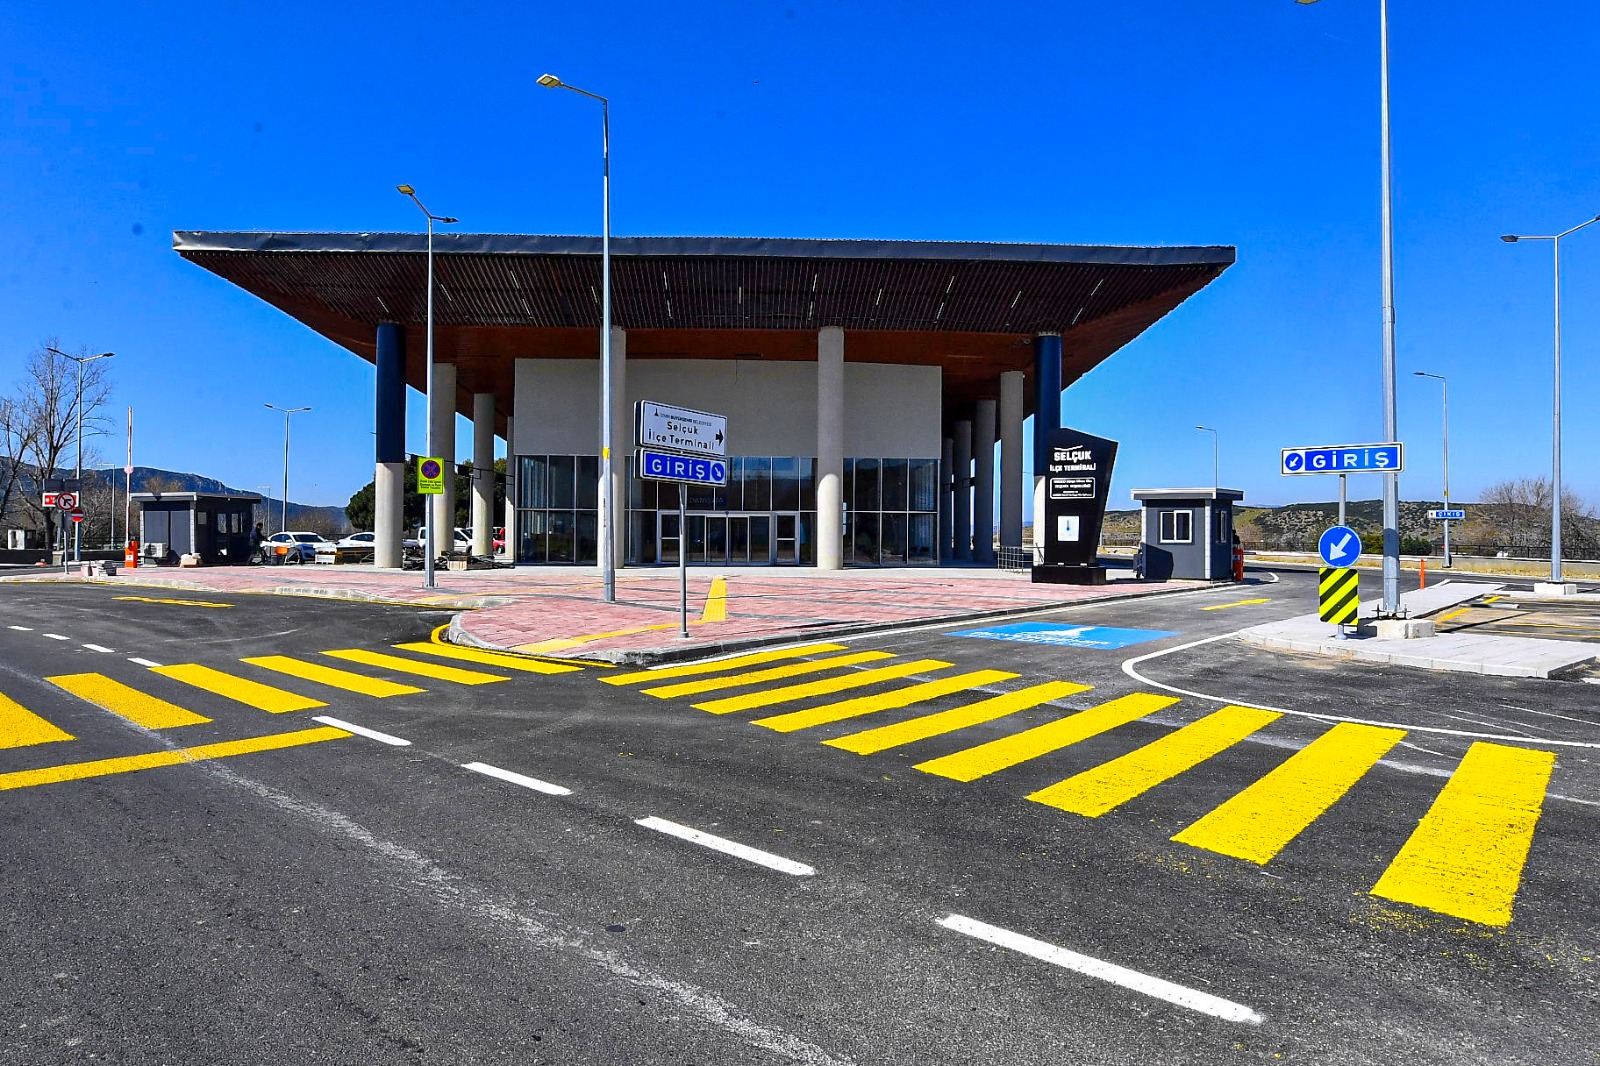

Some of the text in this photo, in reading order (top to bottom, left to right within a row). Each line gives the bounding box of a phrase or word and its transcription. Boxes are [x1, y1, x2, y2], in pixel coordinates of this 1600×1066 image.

[667, 421, 698, 435] Selçuk
[648, 428, 714, 451] İlçe Terminali
[1053, 450, 1092, 463] SELÇUK
[1312, 449, 1390, 468] GİRİŞ
[652, 457, 705, 480] GİRİŞ
